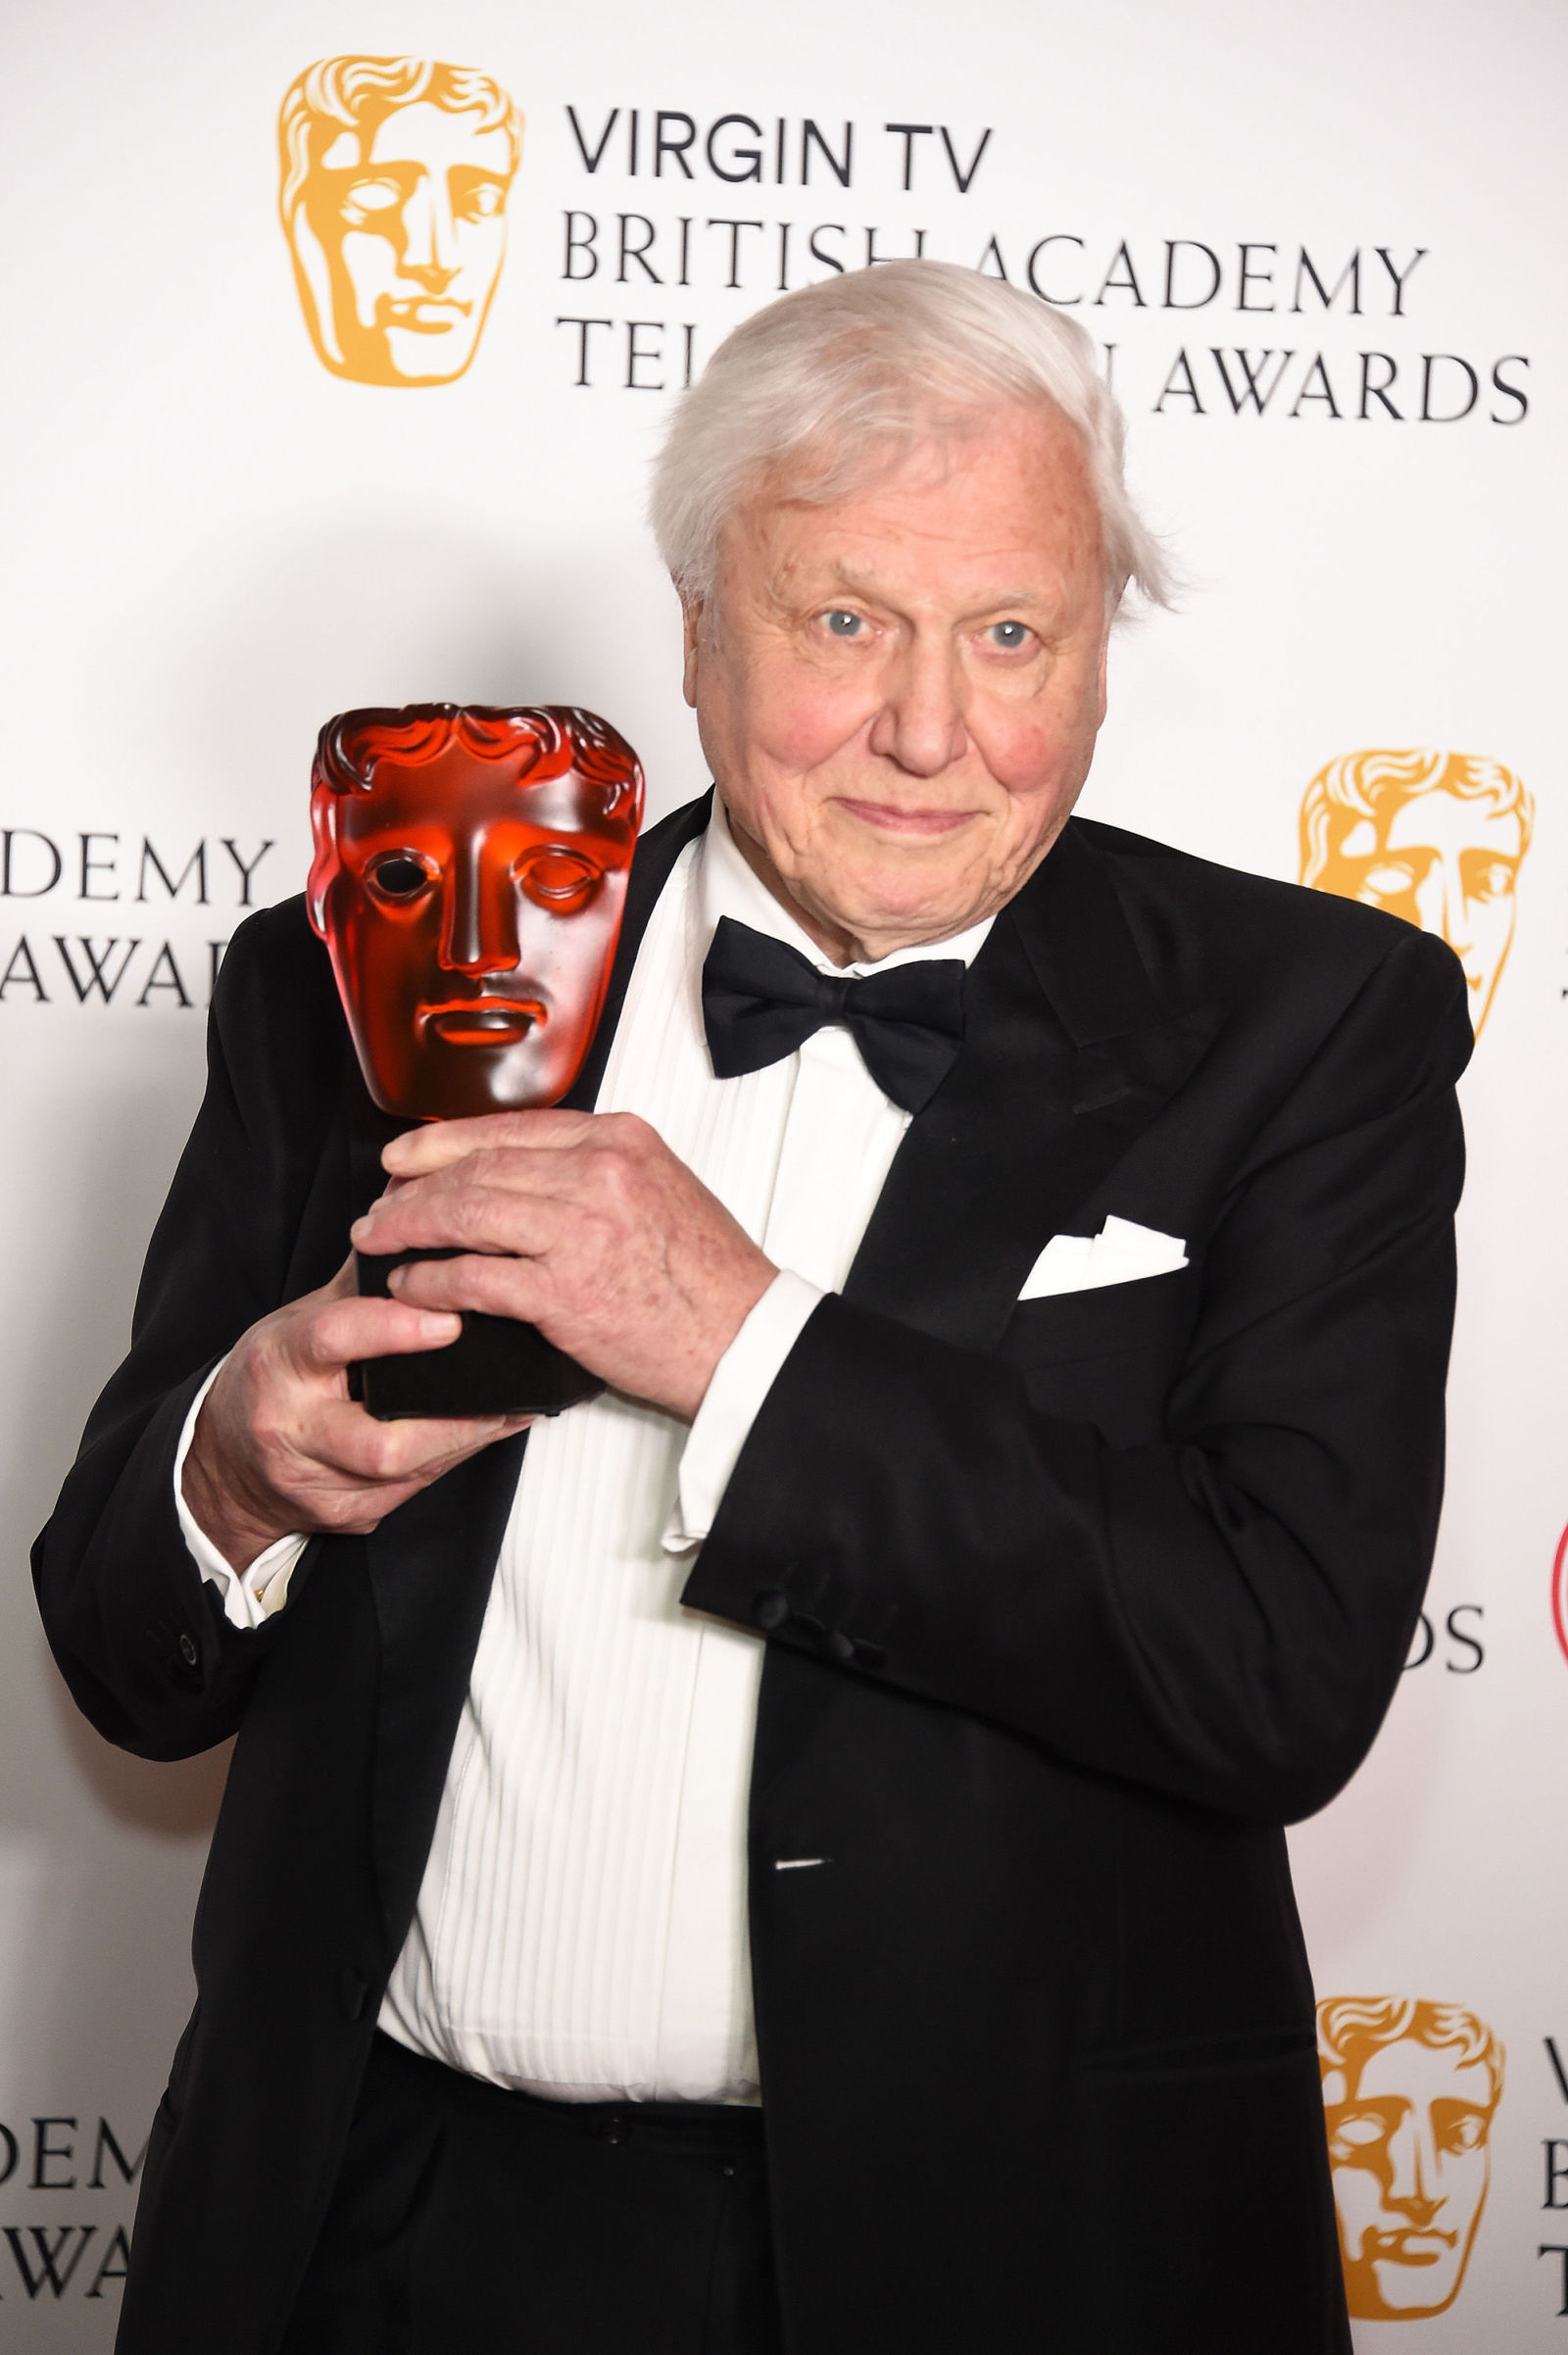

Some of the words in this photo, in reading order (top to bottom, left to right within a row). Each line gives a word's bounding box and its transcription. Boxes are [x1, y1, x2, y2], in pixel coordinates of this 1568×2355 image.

[565, 104, 855, 189] VIRGIN
[885, 122, 994, 194] TV
[980, 233, 1429, 318] ACADEMY
[1152, 346, 1531, 426] AWARDS
[0, 829, 275, 907] DEMY
